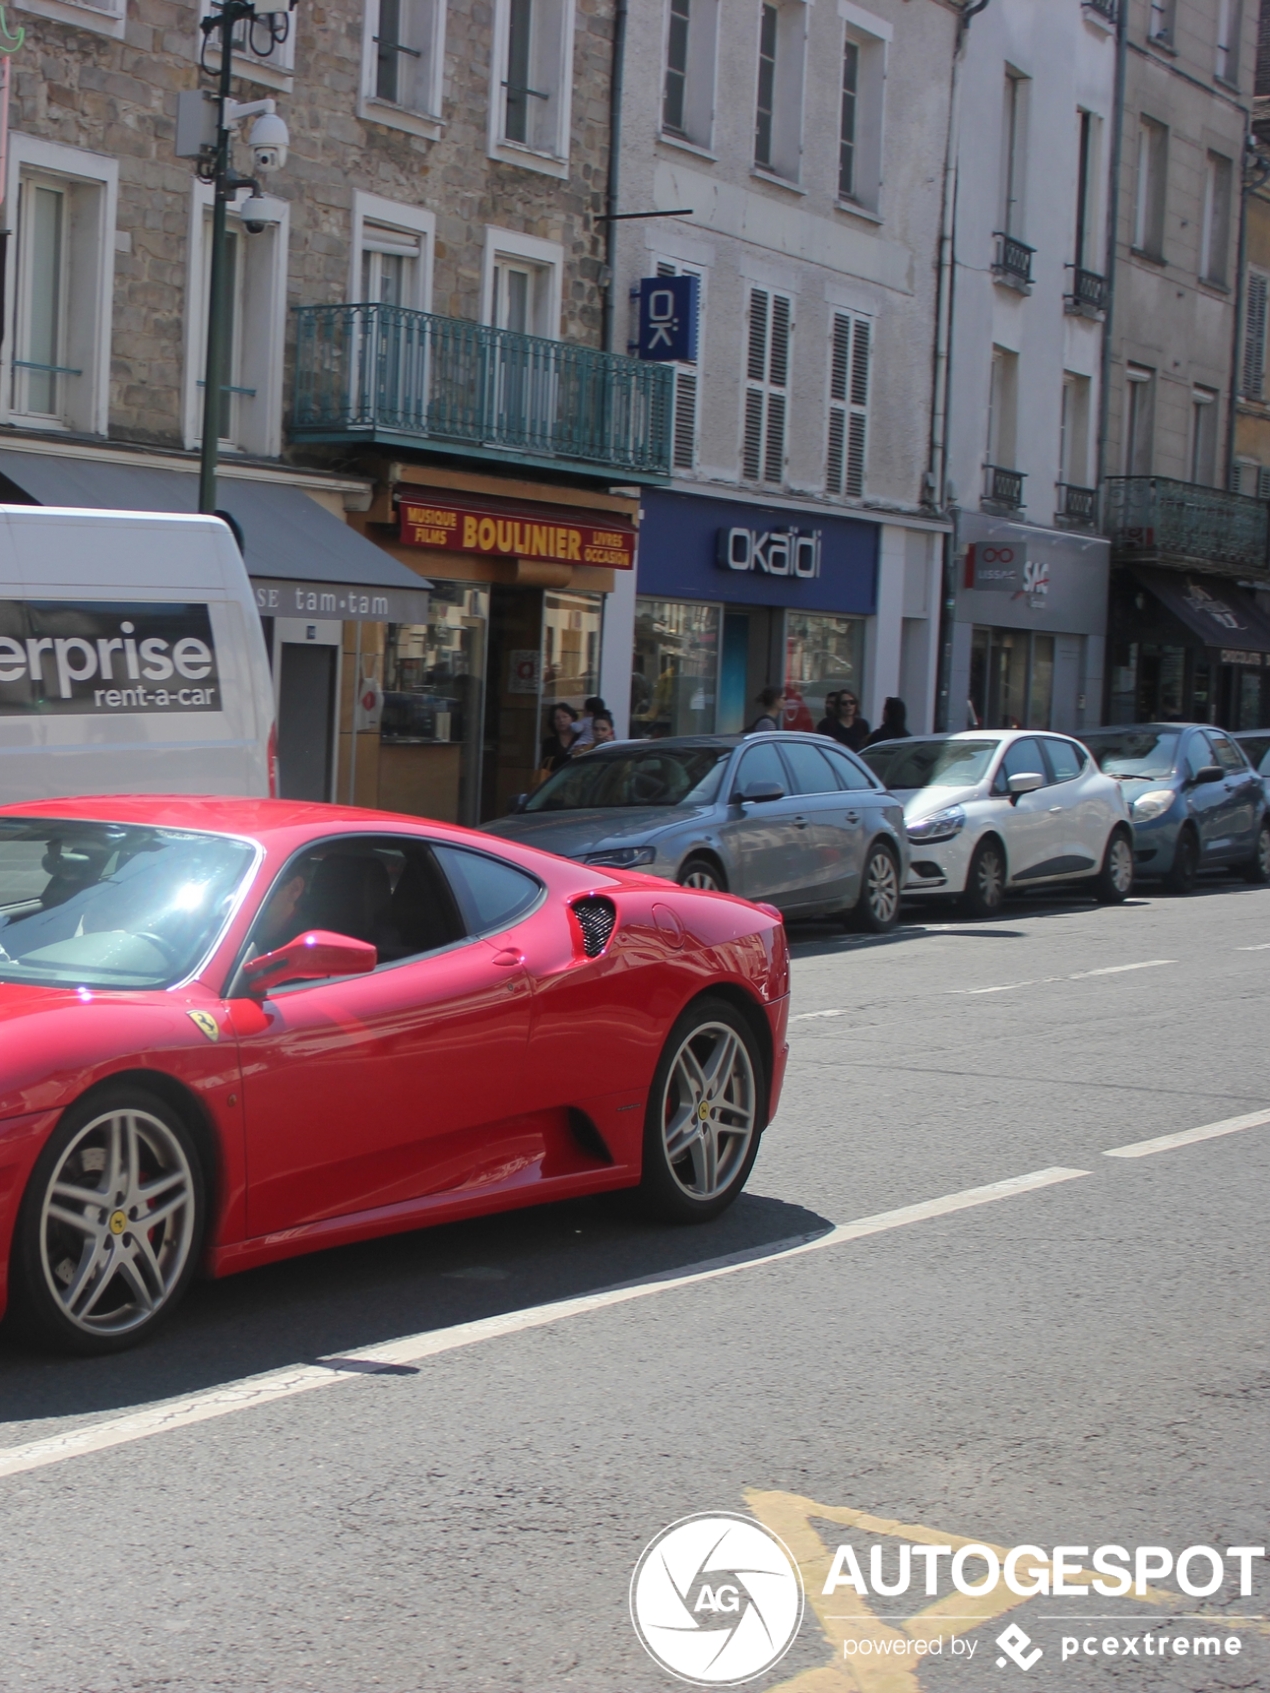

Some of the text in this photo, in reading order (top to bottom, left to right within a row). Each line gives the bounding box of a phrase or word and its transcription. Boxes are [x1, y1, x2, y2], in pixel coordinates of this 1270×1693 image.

[407, 507, 457, 527] MUSIQUE
[415, 528, 447, 545] FILMS
[462, 516, 582, 561] BOULINIER
[592, 531, 623, 547] LIVRES
[585, 548, 630, 567] OCCASION
[94, 684, 215, 707] rent-a-car
